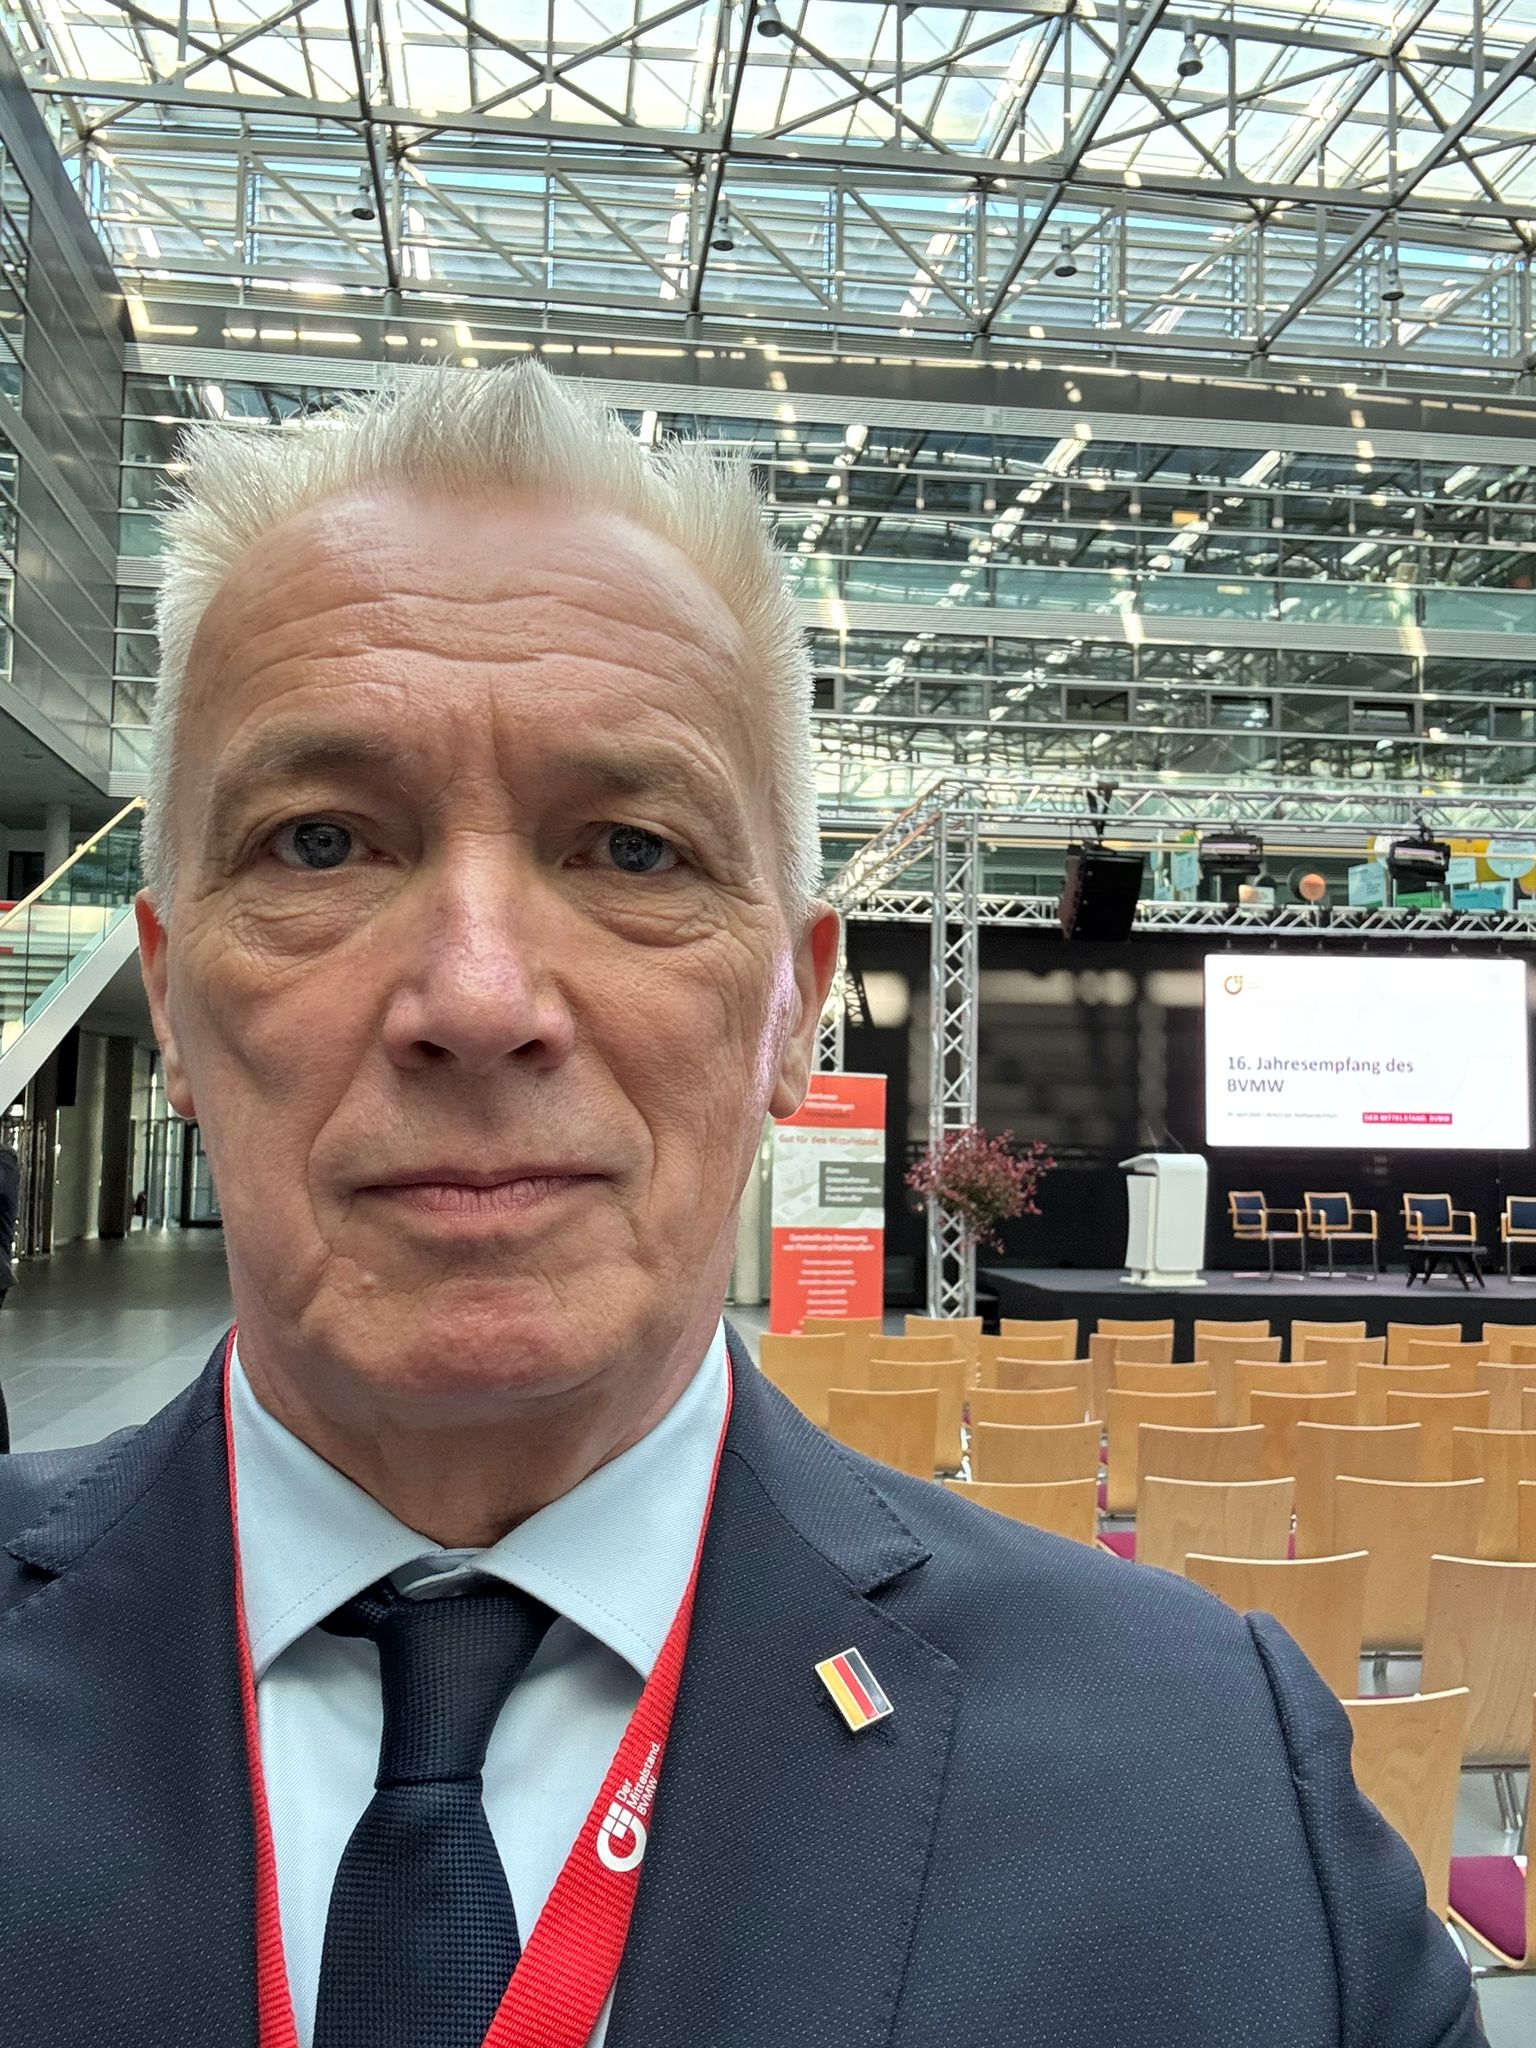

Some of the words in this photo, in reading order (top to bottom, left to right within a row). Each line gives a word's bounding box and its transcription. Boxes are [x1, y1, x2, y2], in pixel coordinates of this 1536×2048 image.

[1228, 1056, 1251, 1071] 16.
[1256, 1056, 1381, 1076] Jahresempfang
[1385, 1057, 1414, 1073] des
[1227, 1078, 1284, 1093] BVMW
[615, 1778, 633, 1802] Der
[636, 1775, 658, 1816] BVMW
